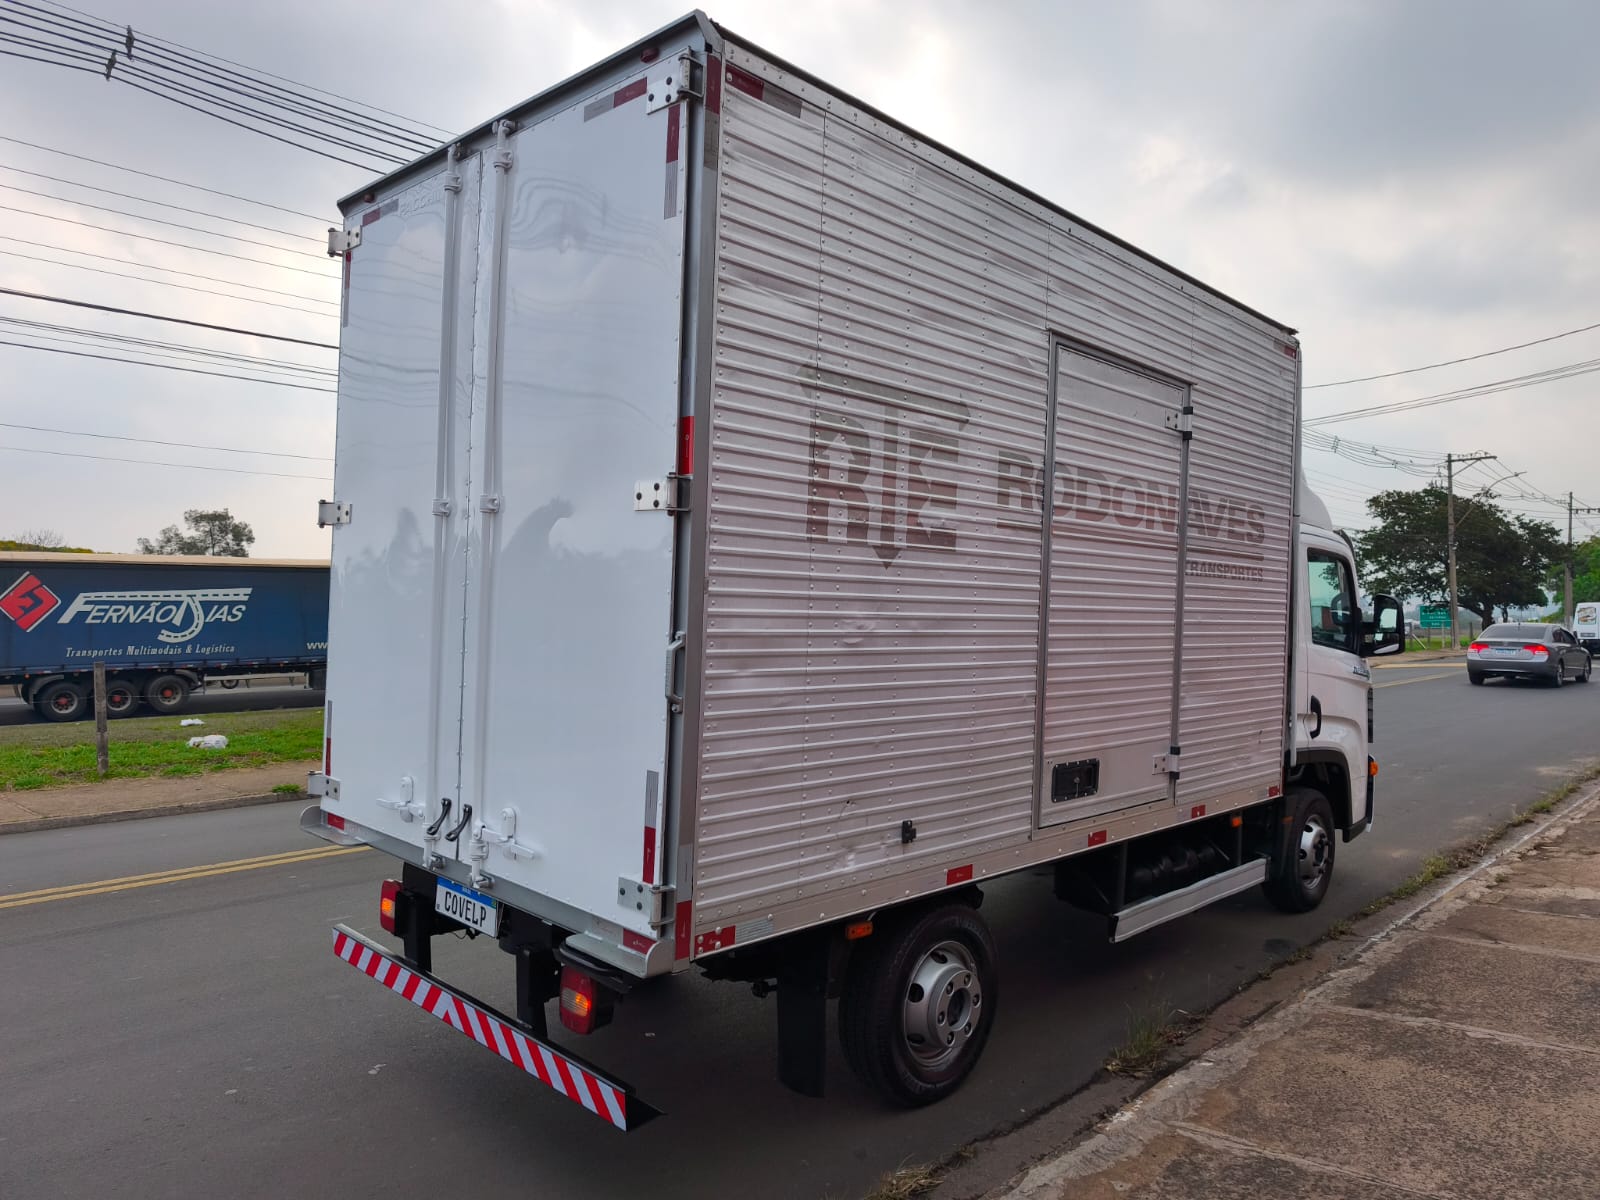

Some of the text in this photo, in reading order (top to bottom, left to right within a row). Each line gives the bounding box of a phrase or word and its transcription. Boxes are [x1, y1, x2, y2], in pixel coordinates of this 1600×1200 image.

[997, 449, 1265, 545] RODONAVES
[57, 591, 177, 624] FERNÃO
[66, 647, 123, 658] Transportes
[126, 644, 182, 656] Multimodais
[186, 644, 192, 654] &
[444, 890, 487, 928] COVELP
